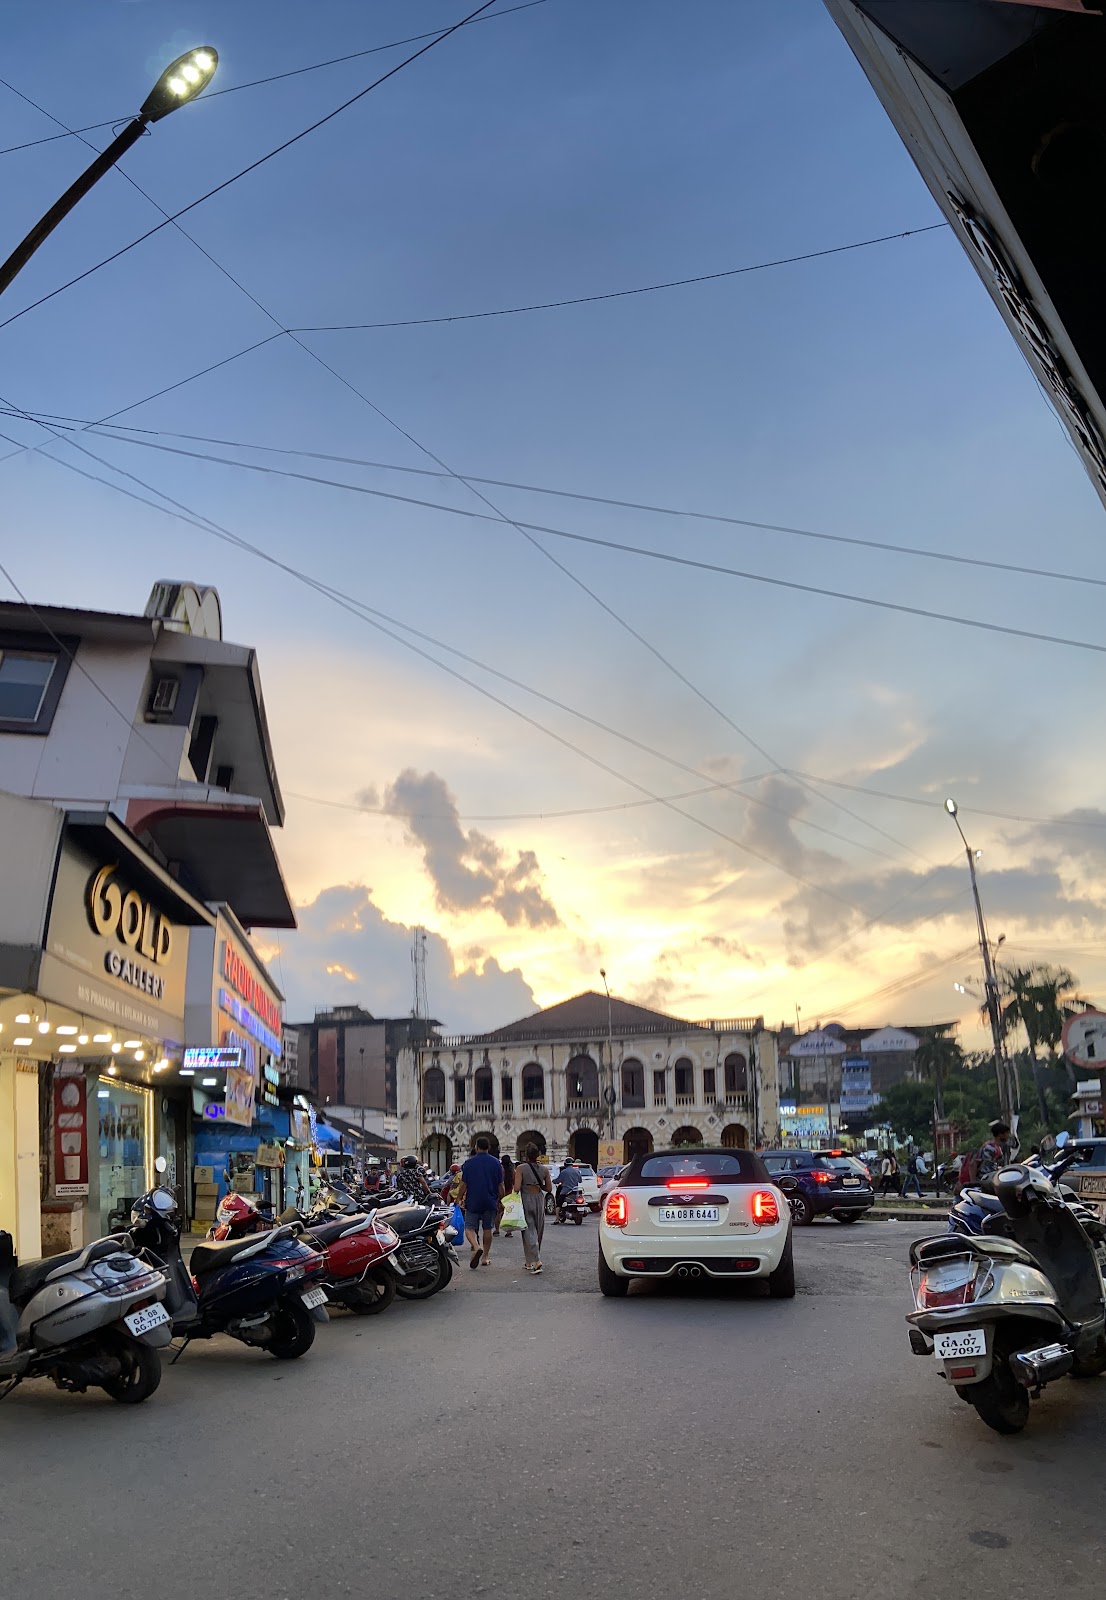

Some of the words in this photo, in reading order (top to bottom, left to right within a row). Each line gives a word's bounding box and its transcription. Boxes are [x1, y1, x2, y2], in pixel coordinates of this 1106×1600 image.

[88, 863, 173, 966] GOLD
[107, 949, 166, 1000] GALLERY
[224, 938, 253, 1003] RADIO
[665, 1210, 676, 1219] GA
[677, 1209, 688, 1219] 08
[689, 1209, 695, 1219] R
[696, 1209, 717, 1219] 6441
[133, 1309, 158, 1325] GA.08
[135, 1313, 167, 1334] AG.7774
[939, 1346, 981, 1357] V.7097
[941, 1338, 977, 1348] GA.07
